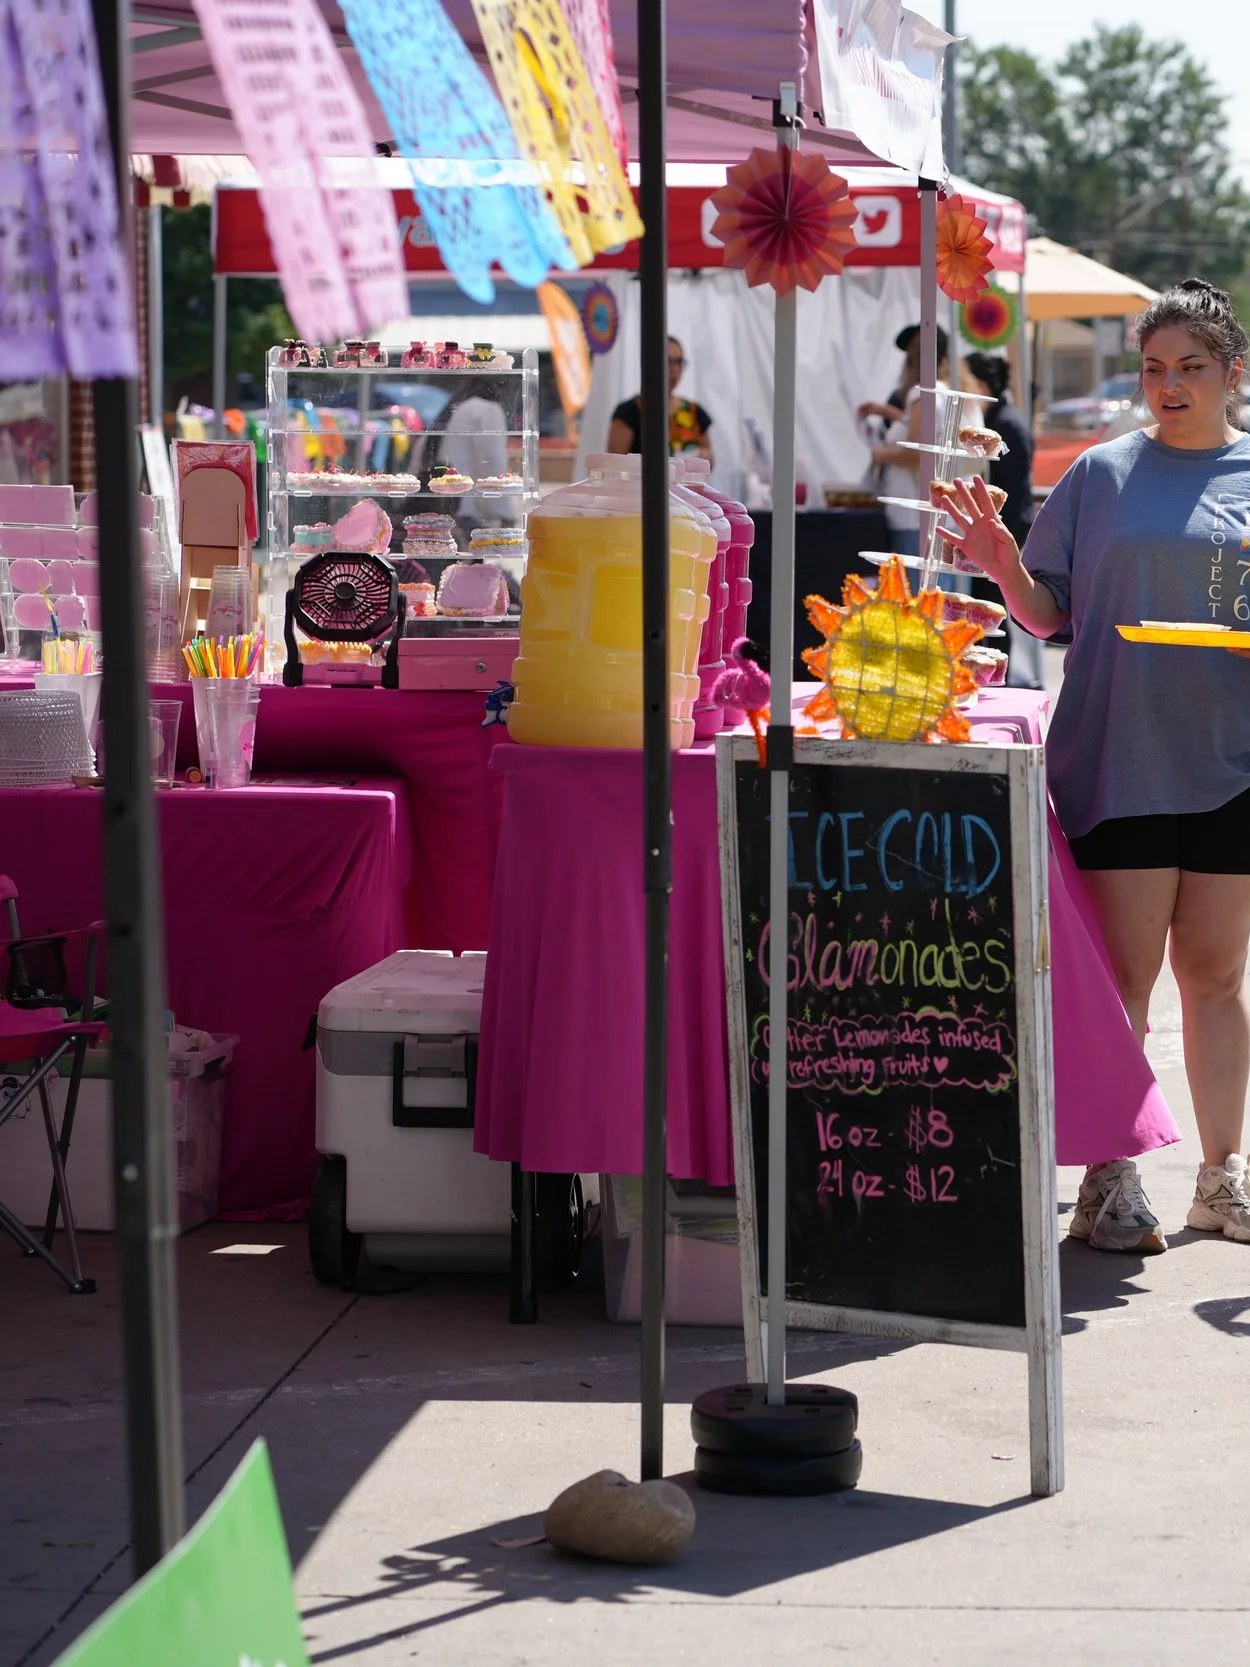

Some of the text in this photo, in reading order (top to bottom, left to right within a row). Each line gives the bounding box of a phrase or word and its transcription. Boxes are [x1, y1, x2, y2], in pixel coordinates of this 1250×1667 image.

[877, 808, 1000, 899] COLD
[832, 1020, 931, 1050] Lemonades
[938, 1023, 1002, 1054] infused
[788, 1049, 876, 1085] refreshing
[816, 1110, 840, 1149] 16
[905, 1104, 954, 1154] $8
[903, 1164, 958, 1204] $12
